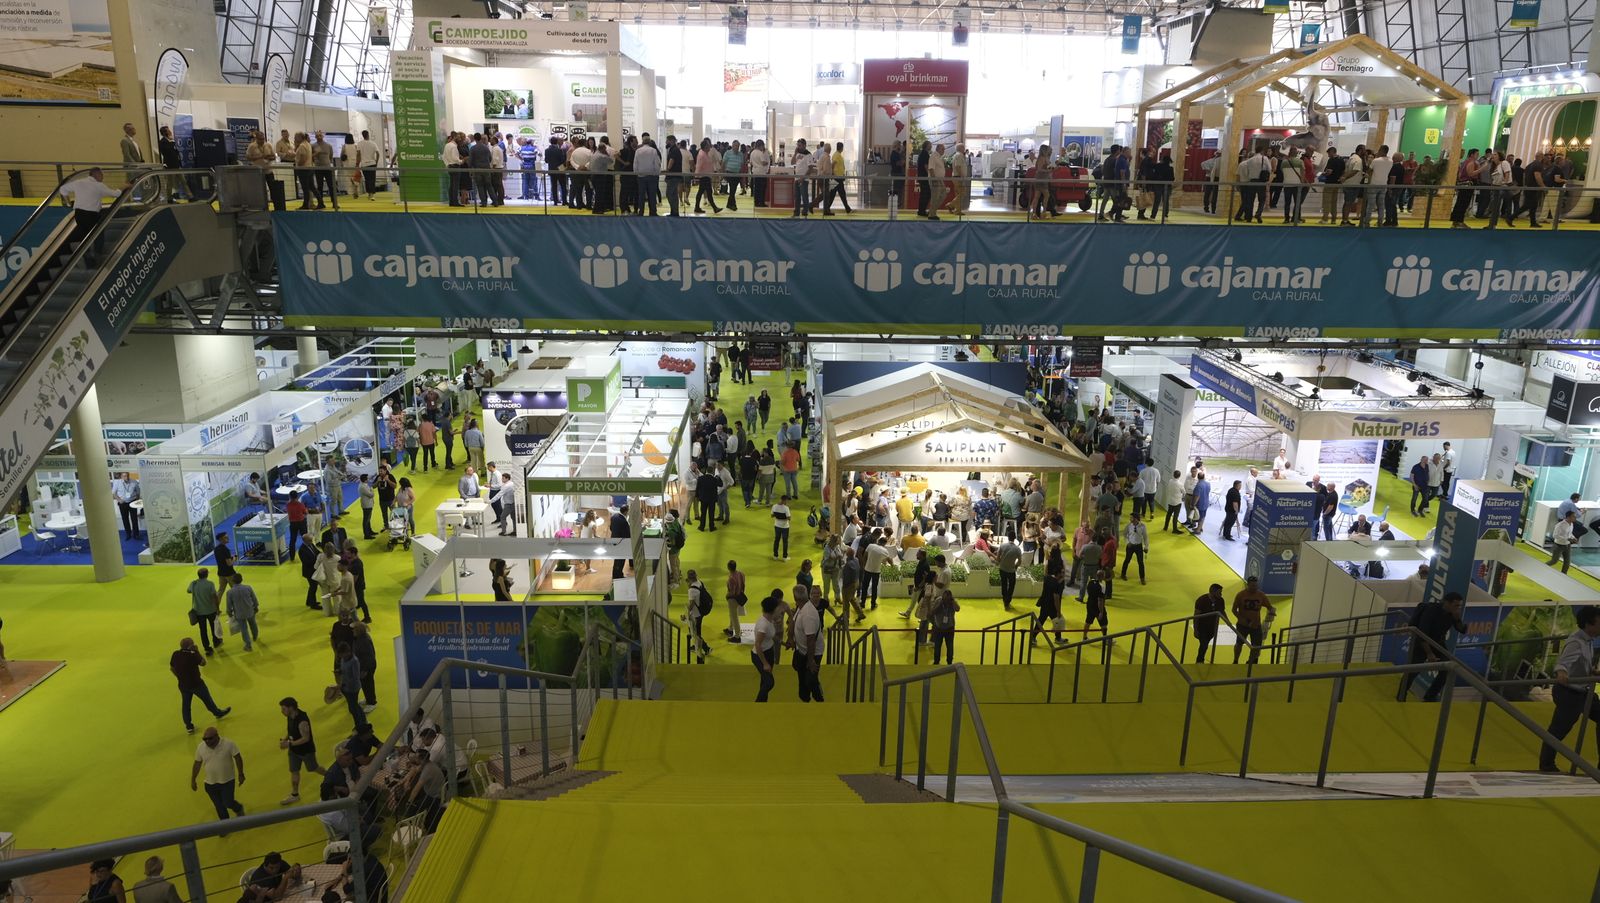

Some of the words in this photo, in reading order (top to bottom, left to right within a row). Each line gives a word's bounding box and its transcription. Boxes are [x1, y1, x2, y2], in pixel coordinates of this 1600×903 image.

[446, 28, 528, 40] CAMPOEJIDO
[1337, 56, 1360, 64] Grupo
[1337, 64, 1374, 73] Tecniagro
[887, 73, 908, 84] royal
[910, 72, 948, 83] brinkman
[98, 293, 110, 311] El
[108, 263, 132, 298] mejor
[130, 231, 157, 267] injerto
[364, 244, 520, 288] cajamar
[640, 248, 795, 291] cajamar
[913, 253, 1068, 294] cajamar
[1181, 256, 1331, 297] cajamar
[108, 297, 127, 328] para
[125, 284, 136, 298] tu
[135, 242, 165, 285] cosecha
[442, 281, 474, 290] CAJA
[477, 281, 518, 291] RURAL
[1442, 260, 1590, 300] cajamar
[717, 285, 748, 295] CAJA
[752, 285, 791, 295] RURAL
[987, 288, 1018, 298] CAJA
[1022, 288, 1061, 298] RURAL
[1252, 290, 1284, 300] CAJA
[1286, 291, 1324, 301] RURAL
[1509, 294, 1538, 304] CAJA
[1542, 294, 1577, 304] RURAL
[453, 317, 520, 328] ADNAGRO
[726, 321, 790, 332] ADNAGRO
[993, 324, 1058, 336] ADNAGRO
[1255, 326, 1319, 338] ADNAGRO
[1510, 329, 1571, 339] ADNAGRO
[1352, 421, 1440, 437] NaturPláS
[925, 442, 1006, 453] SALIPLANT
[577, 482, 626, 492] PRAYON
[414, 621, 473, 635] ROQUETAS
[477, 621, 491, 635] DE
[495, 622, 521, 635] MAR
[1467, 622, 1493, 634] MAR
[428, 636, 436, 644] A
